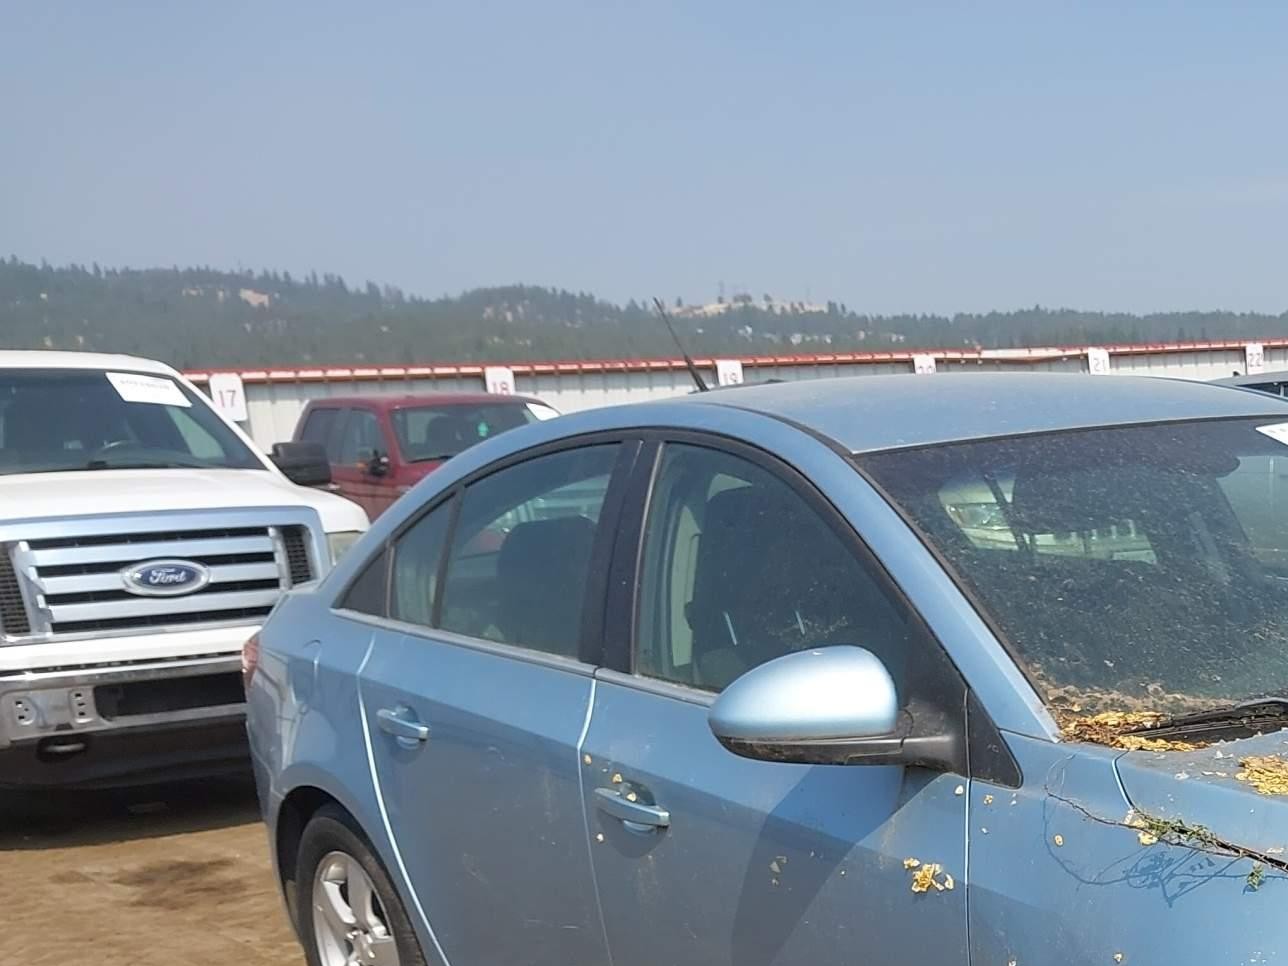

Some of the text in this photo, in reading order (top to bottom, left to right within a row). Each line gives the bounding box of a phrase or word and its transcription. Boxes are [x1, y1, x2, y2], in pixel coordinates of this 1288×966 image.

[1093, 357, 1106, 371] 21
[1248, 352, 1262, 367] 22
[493, 381, 508, 396] 18
[218, 389, 236, 408] 17
[149, 568, 187, 584] Ford
